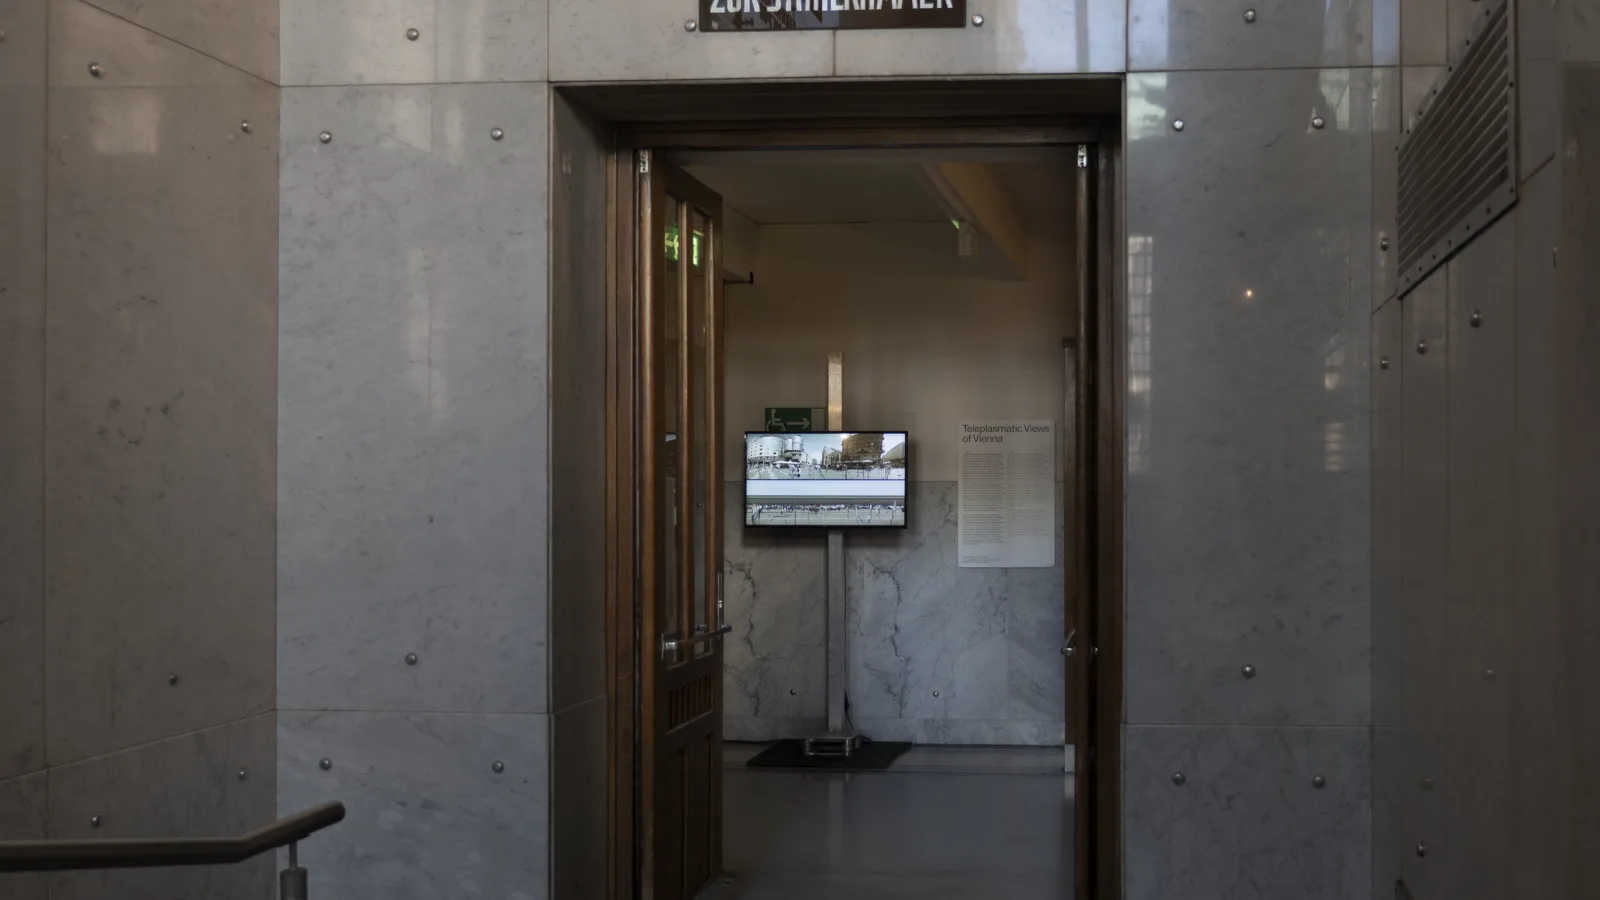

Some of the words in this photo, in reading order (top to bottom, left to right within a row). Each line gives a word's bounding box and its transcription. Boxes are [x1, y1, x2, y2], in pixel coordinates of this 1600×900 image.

[962, 424, 1022, 434] Teleplasmatic
[1023, 424, 1050, 433] Views
[962, 434, 972, 443] of
[973, 434, 1003, 443] Vienna
